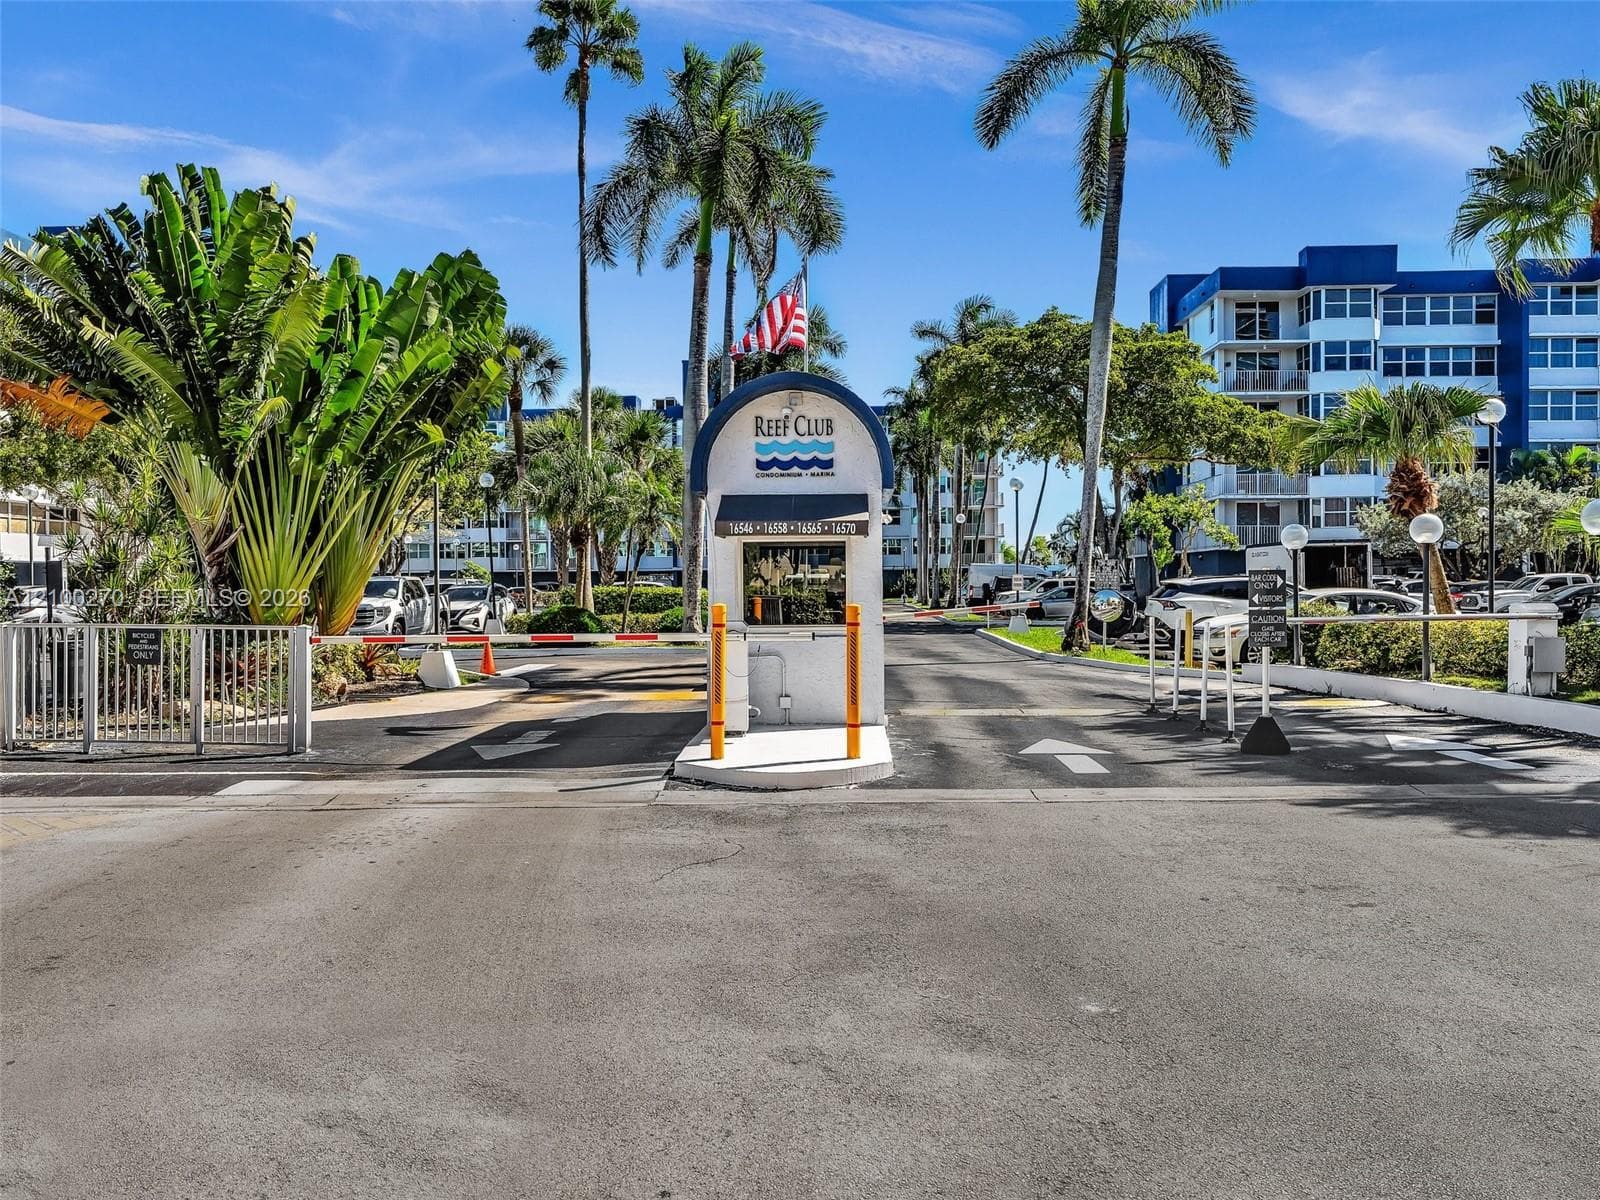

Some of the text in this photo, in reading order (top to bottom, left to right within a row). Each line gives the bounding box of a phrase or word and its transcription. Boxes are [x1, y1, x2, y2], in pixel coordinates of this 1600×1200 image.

[794, 415, 834, 437] CLUB
[729, 522, 856, 535] 16546 16558 16565 16570
[1262, 573, 1277, 582] CODE
[1251, 614, 1285, 624] CAUTION
[132, 632, 155, 640] BICYCLES
[127, 643, 160, 651] PEDESTRIANS
[133, 650, 154, 660] ONLY
